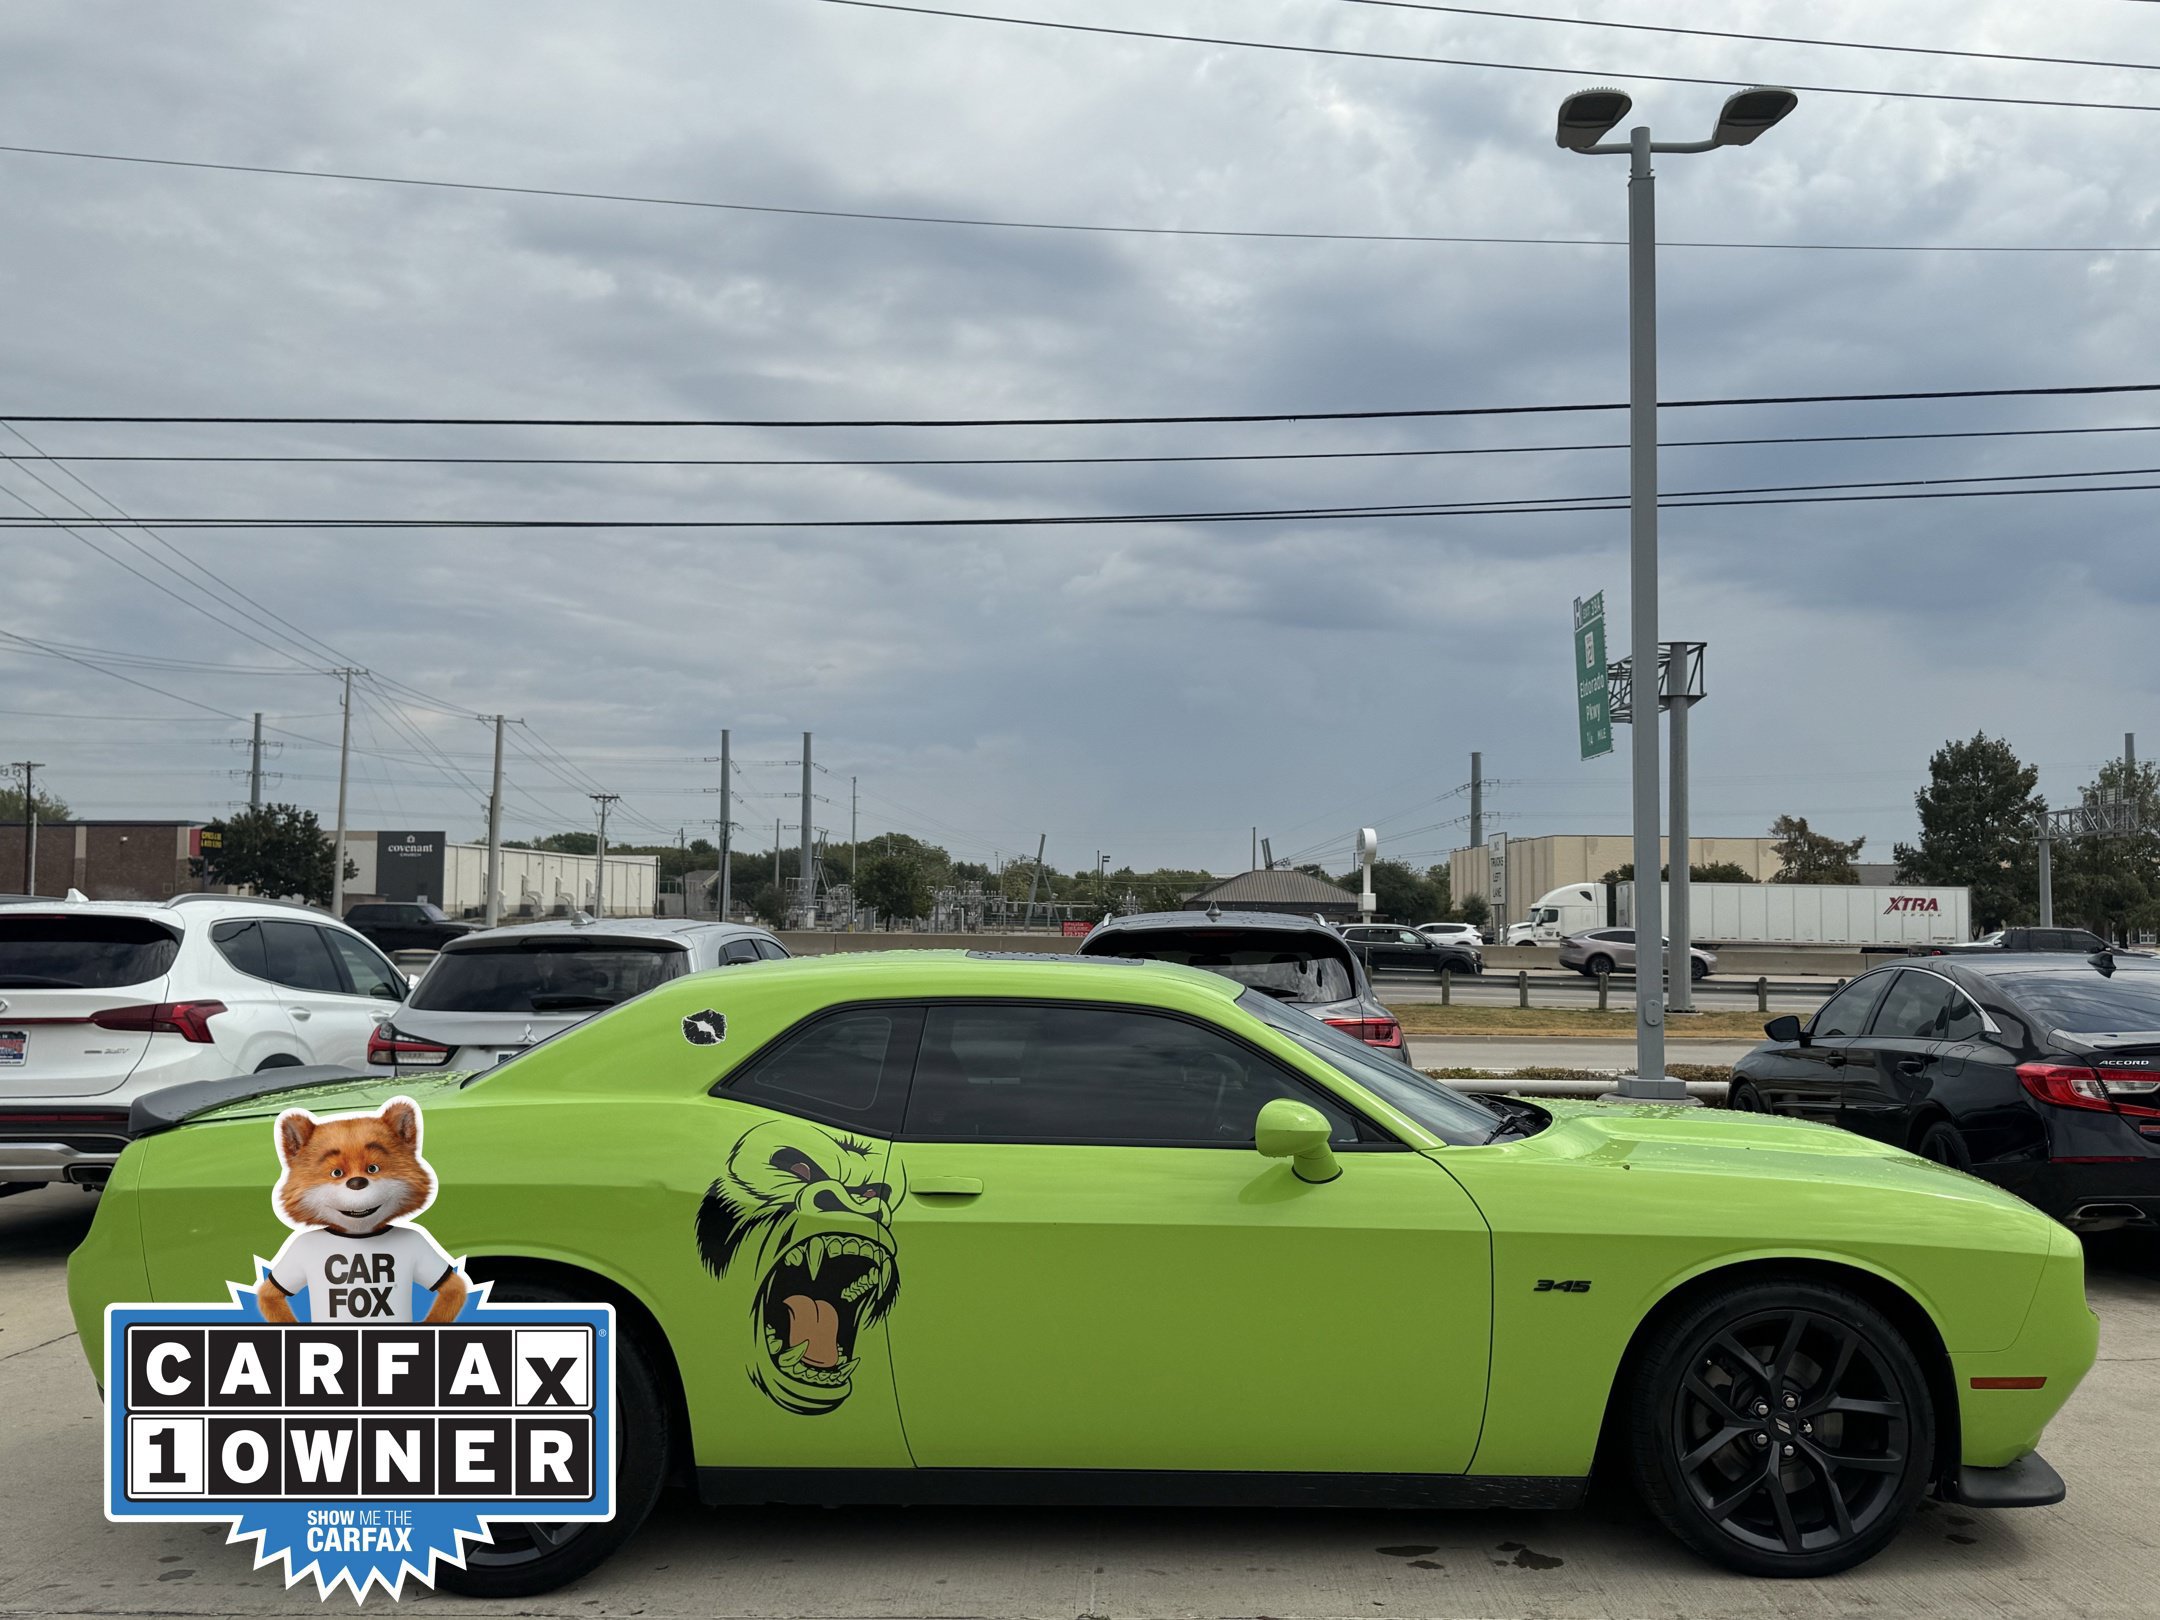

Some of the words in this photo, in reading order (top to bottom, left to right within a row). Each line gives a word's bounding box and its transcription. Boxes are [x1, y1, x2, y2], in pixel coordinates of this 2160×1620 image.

[1580, 672, 1604, 698] Eldorado
[1586, 703, 1600, 721] Pkwy
[388, 844, 433, 852] covenant
[1491, 856, 1504, 867] TRUCKS
[1883, 896, 1939, 914] XTRA
[1533, 1279, 1592, 1293] 345
